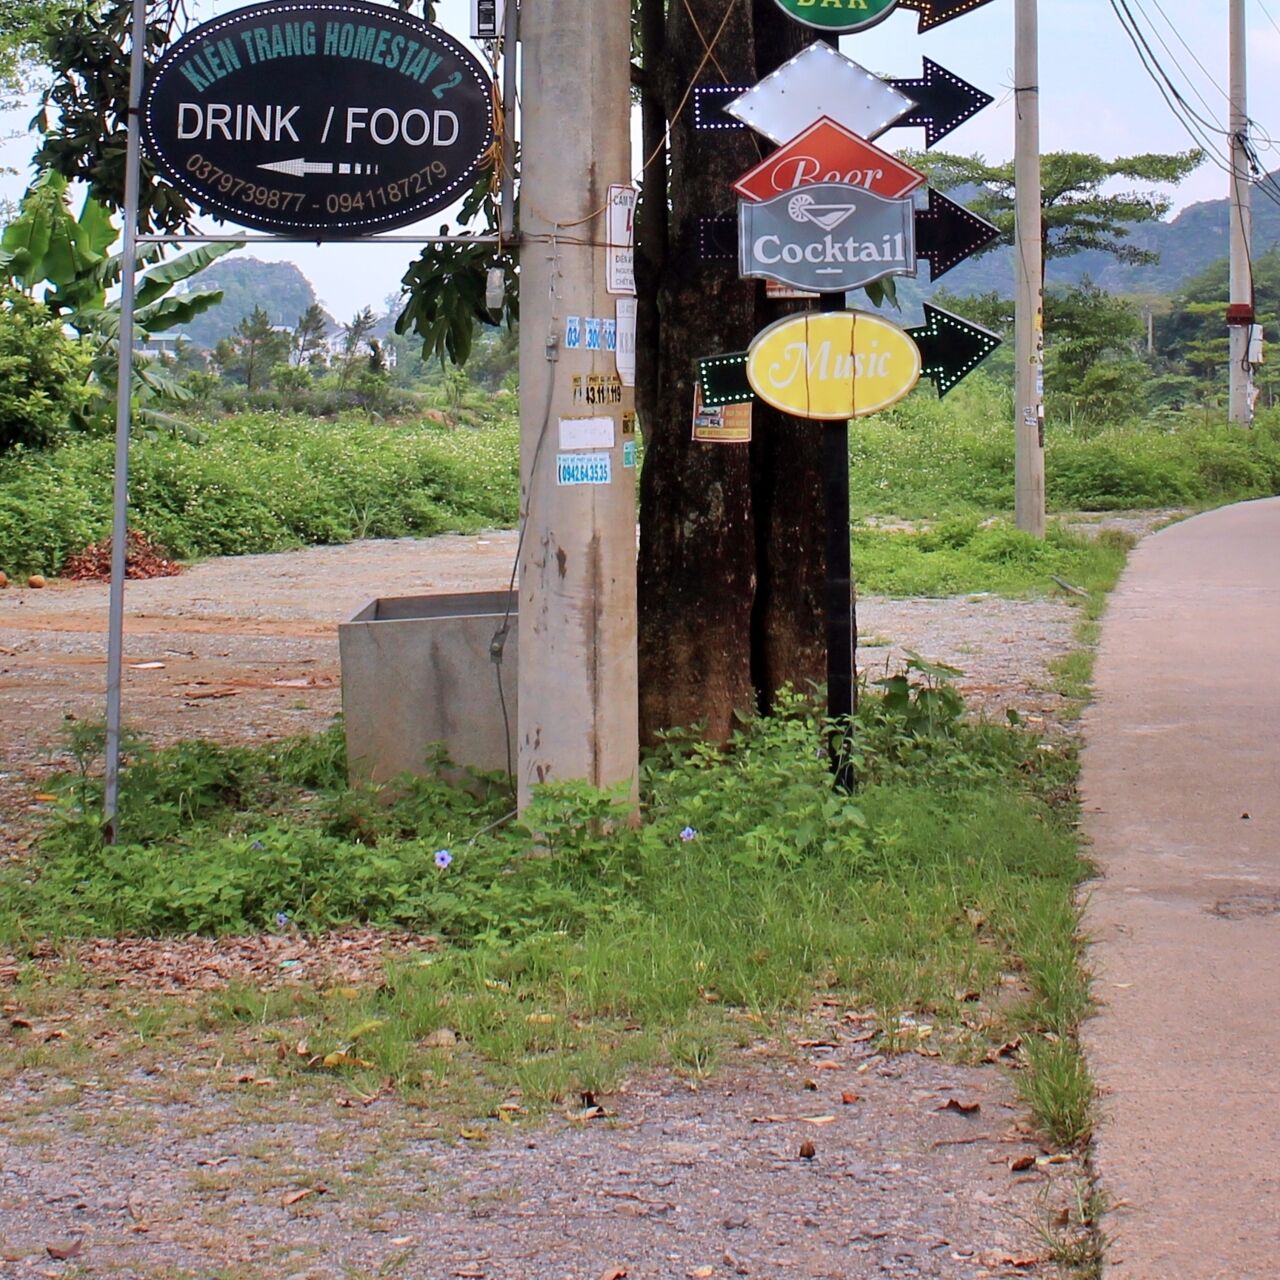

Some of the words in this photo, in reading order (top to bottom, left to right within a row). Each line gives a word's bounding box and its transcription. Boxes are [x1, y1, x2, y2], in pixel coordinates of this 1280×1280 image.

[178, 37, 242, 93] KIÊN
[240, 20, 317, 65] TRANG
[323, 21, 444, 84] HOMESTAY
[431, 71, 463, 100] 2
[177, 103, 301, 143] DRINK
[345, 107, 460, 147] FOOD
[185, 153, 307, 211] 0379739877
[326, 160, 448, 214] 0941187279
[752, 231, 906, 265] Cocktail
[767, 339, 893, 389] Music
